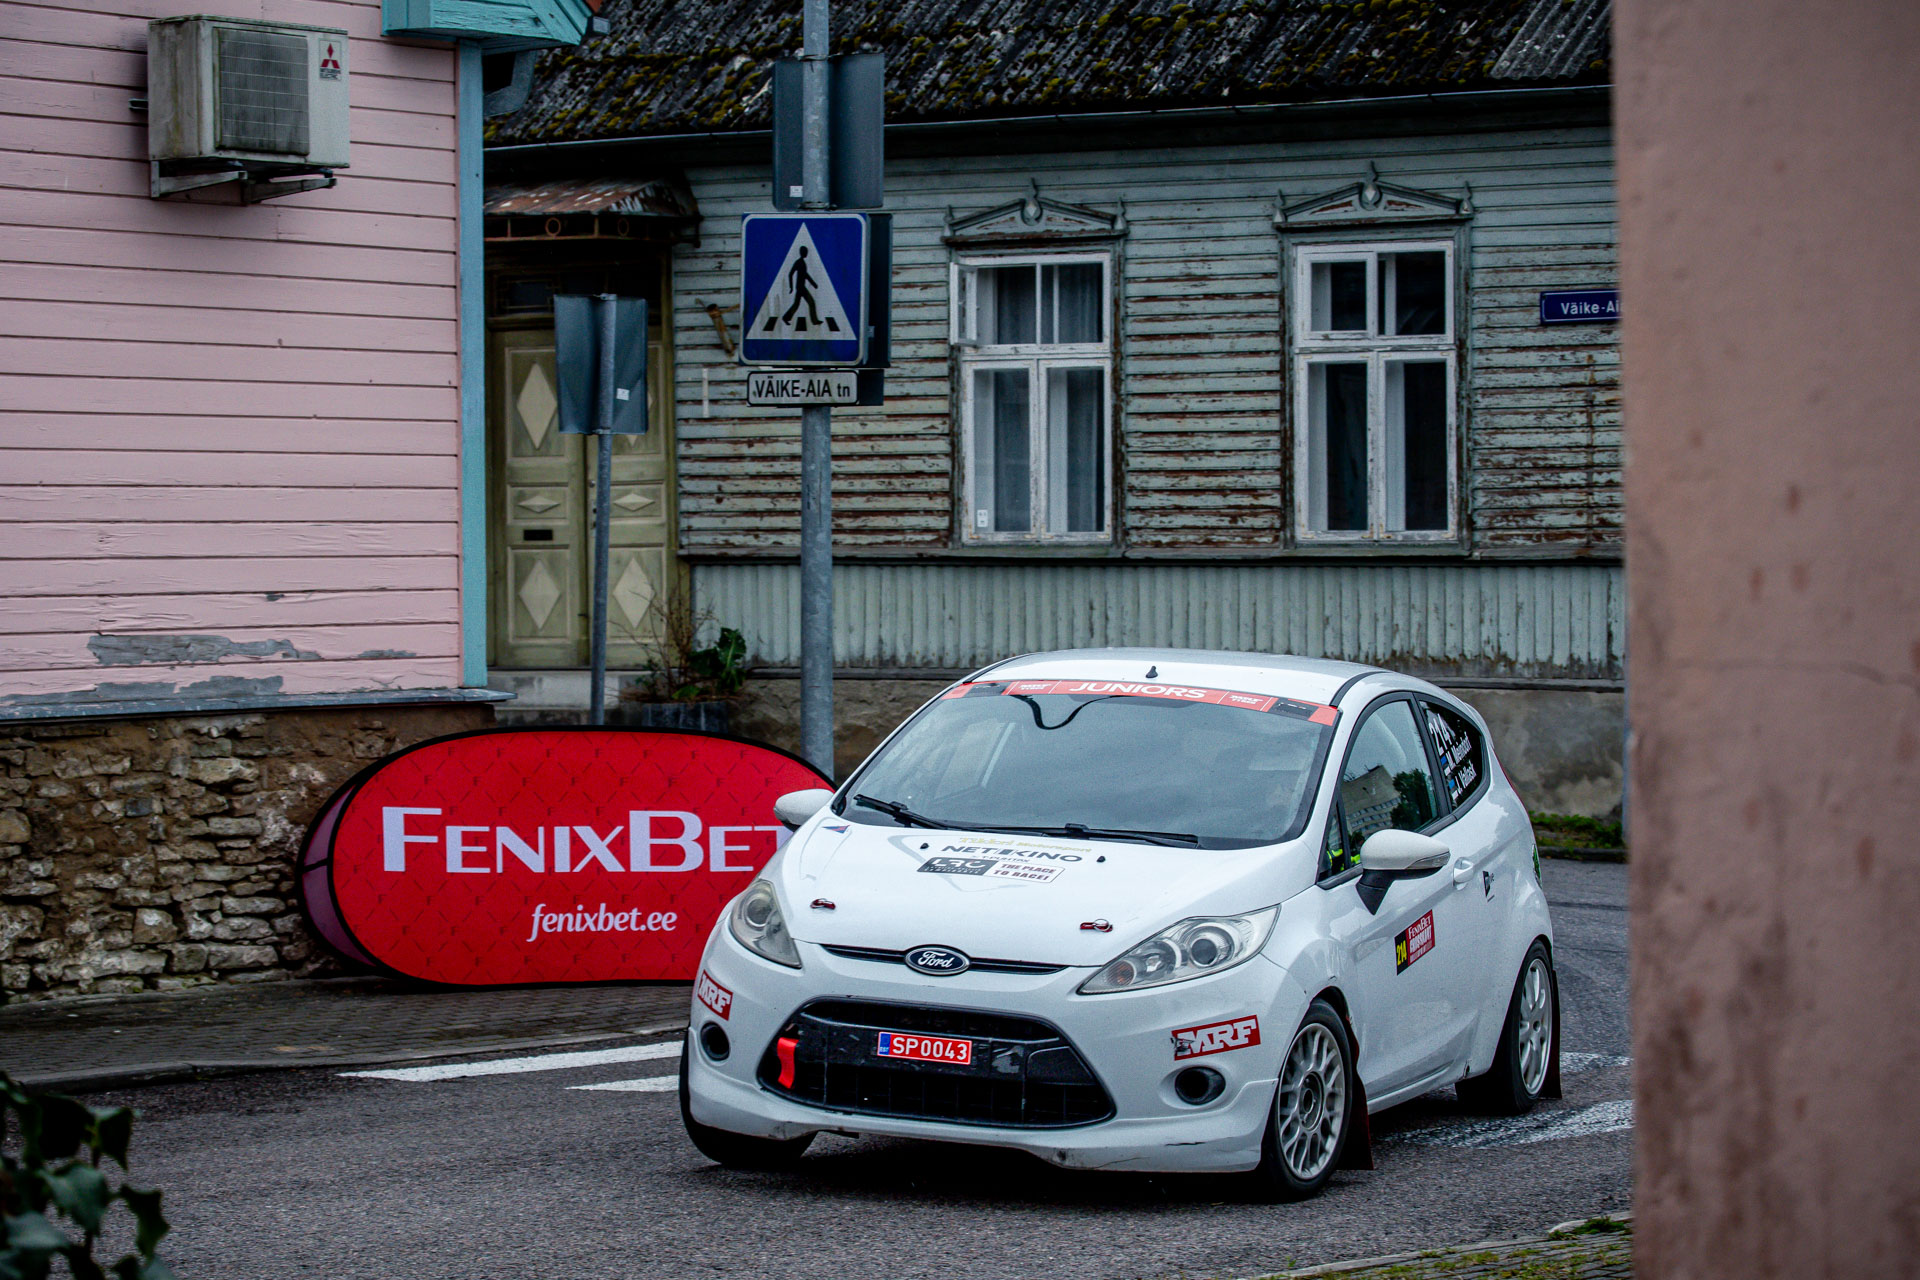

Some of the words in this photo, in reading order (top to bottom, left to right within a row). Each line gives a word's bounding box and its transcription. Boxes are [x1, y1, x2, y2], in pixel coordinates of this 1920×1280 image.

[755, 375, 832, 398] VÄIKE-AIA
[837, 383, 850, 397] tn
[1069, 682, 1208, 699] JUNIORS
[1428, 713, 1453, 756] 214
[1001, 863, 1020, 871] THE
[1022, 865, 1057, 875] PLACE
[1012, 871, 1050, 881] RACE!
[527, 902, 677, 942] fenixbet.ee
[917, 950, 955, 968] Ford
[1396, 939, 1408, 966] 214
[892, 1037, 968, 1060] SP0043
[1175, 1018, 1257, 1057] MRF
